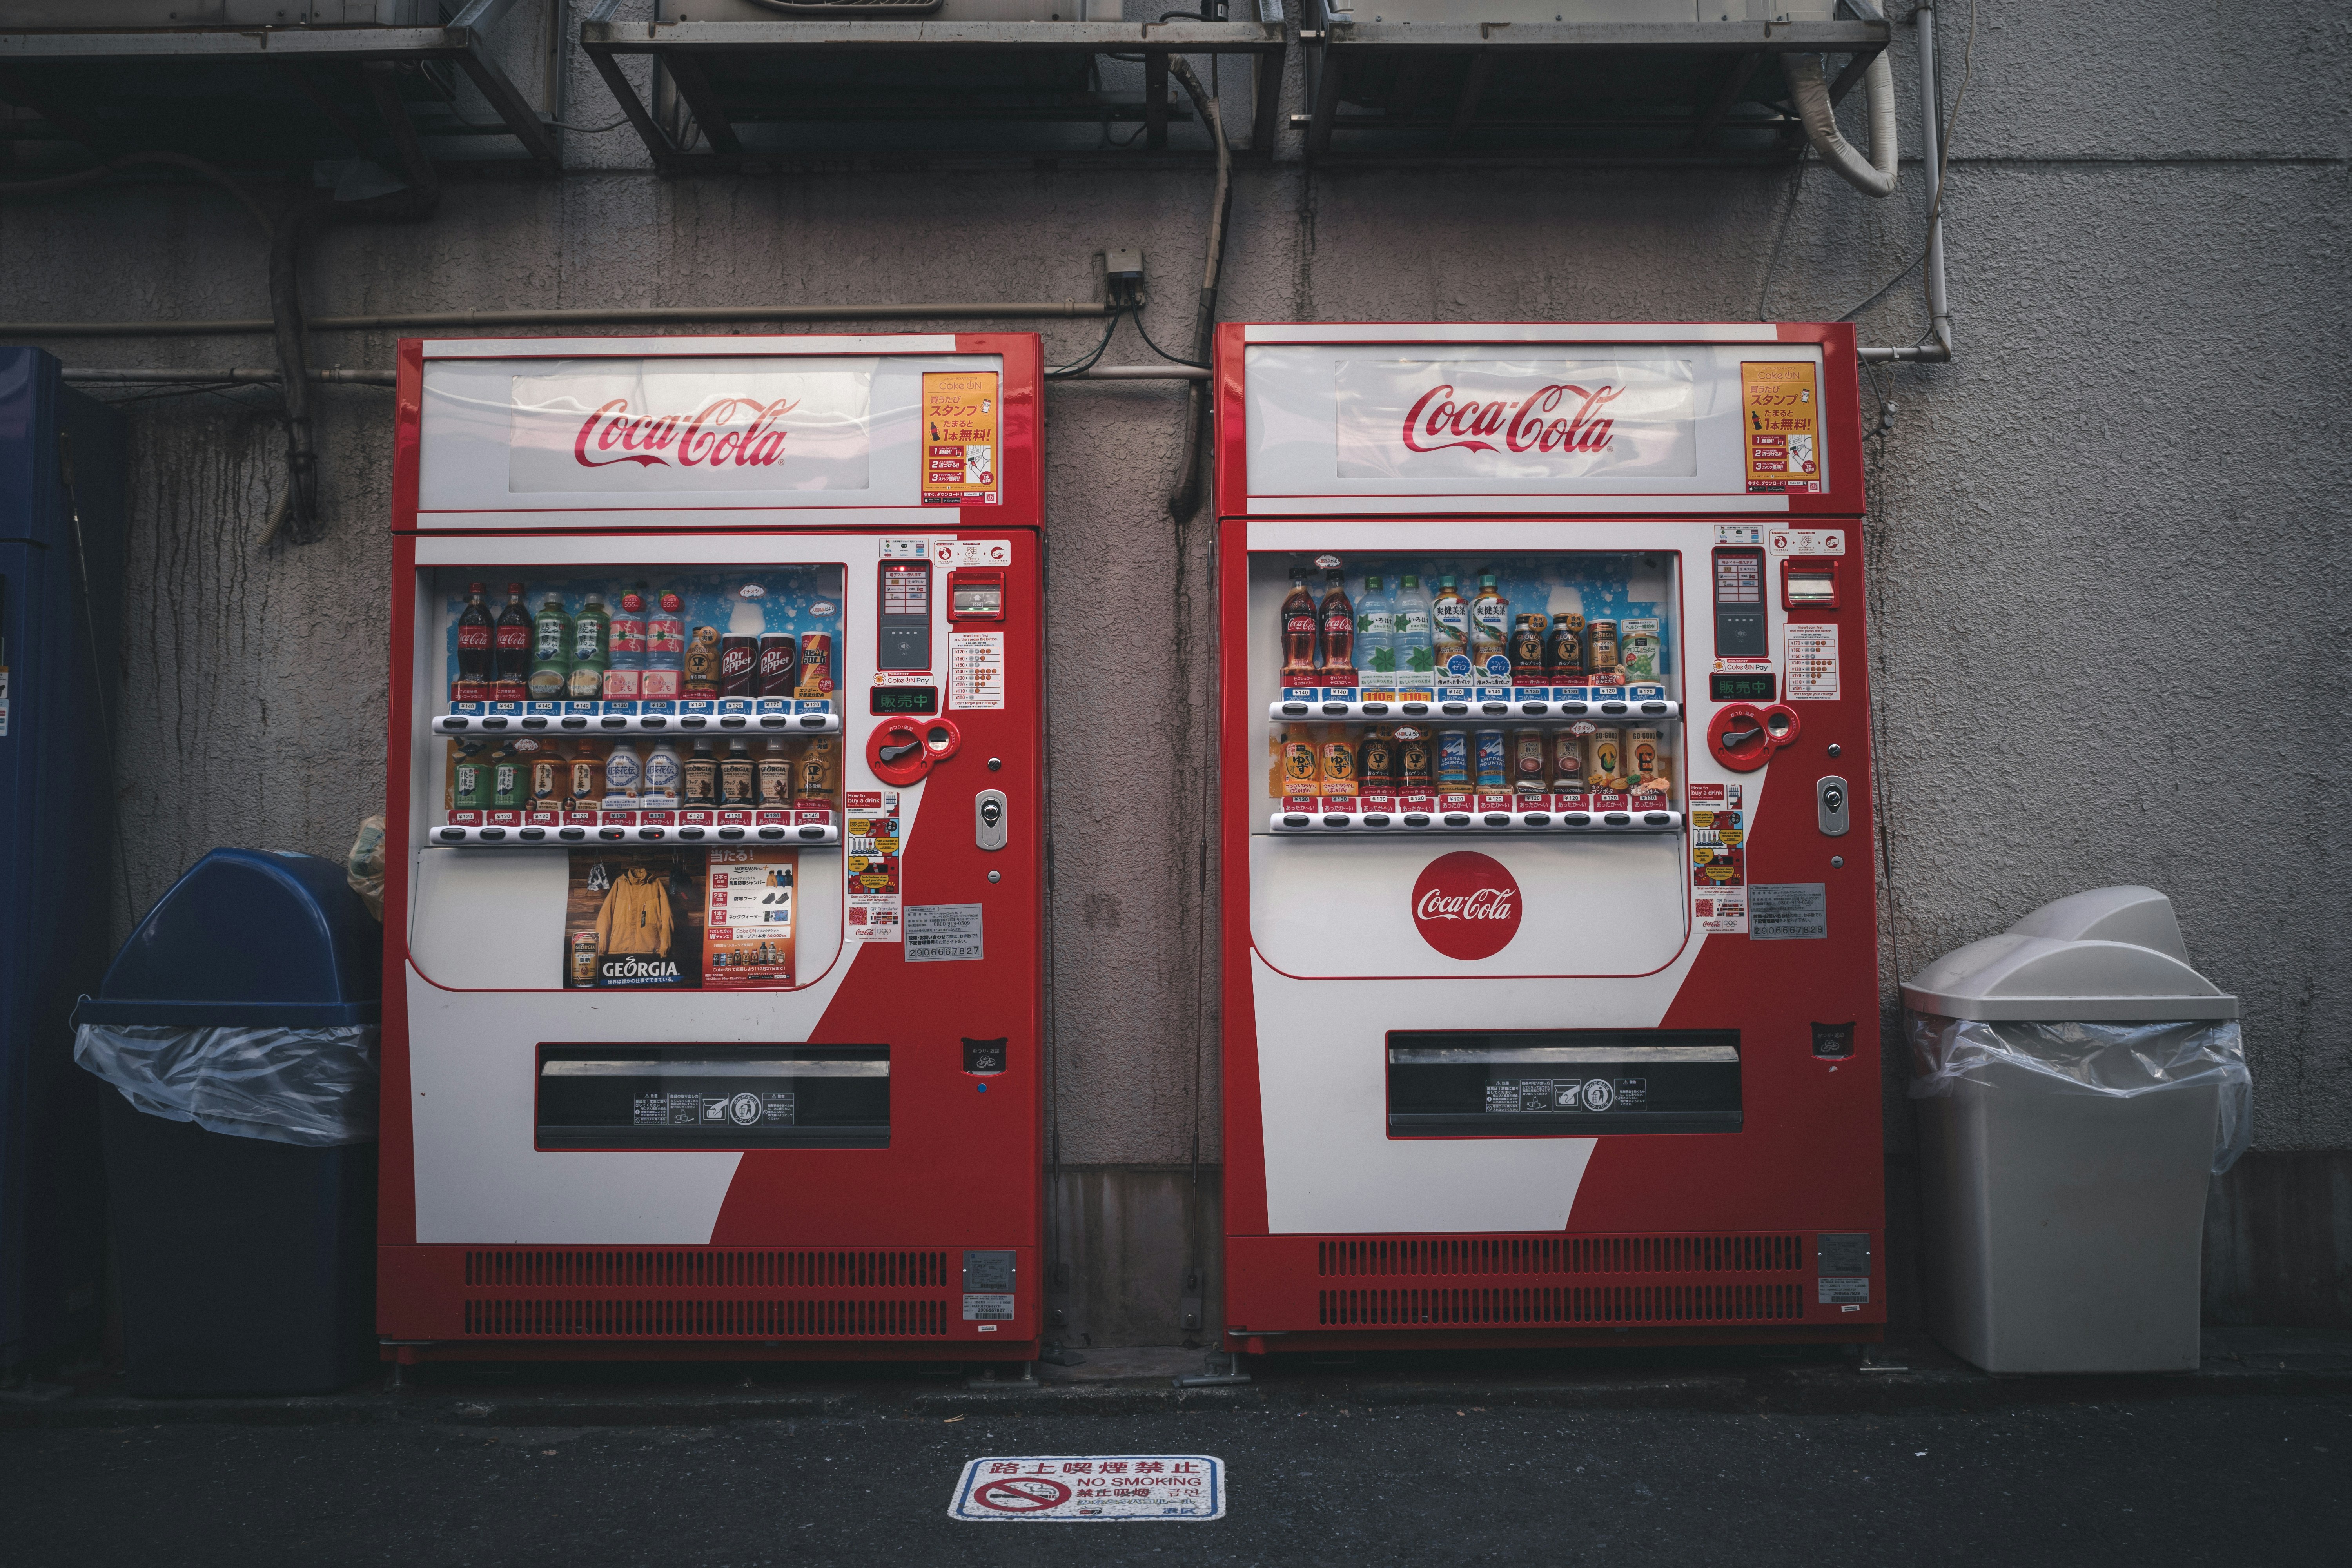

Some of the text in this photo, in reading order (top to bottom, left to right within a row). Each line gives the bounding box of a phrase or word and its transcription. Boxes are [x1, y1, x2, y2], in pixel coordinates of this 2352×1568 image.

[1751, 394, 1798, 406] スタンプ
[930, 405, 978, 416] スタンプ
[1403, 384, 1626, 454] Coca-Cola
[574, 398, 801, 467] Coca-Cola
[943, 429, 991, 441] 1本無料!
[1437, 606, 1466, 616] 爽健美茶
[1477, 605, 1506, 616] 爽健美茶
[729, 651, 743, 662] Dr
[768, 651, 781, 662] Dr
[803, 647, 826, 657] REAL
[722, 657, 751, 675] Pepper
[760, 657, 789, 675] Pepper
[803, 656, 826, 664] GOLD
[1720, 681, 1766, 694] 販売中
[881, 694, 927, 708] 販売中
[608, 766, 635, 775] 紅茶花伝
[1417, 889, 1516, 920] Coca-Cola
[989, 1461, 1201, 1474] 路上喫煙禁止
[1077, 1488, 1149, 1497] 禁止吸烟
